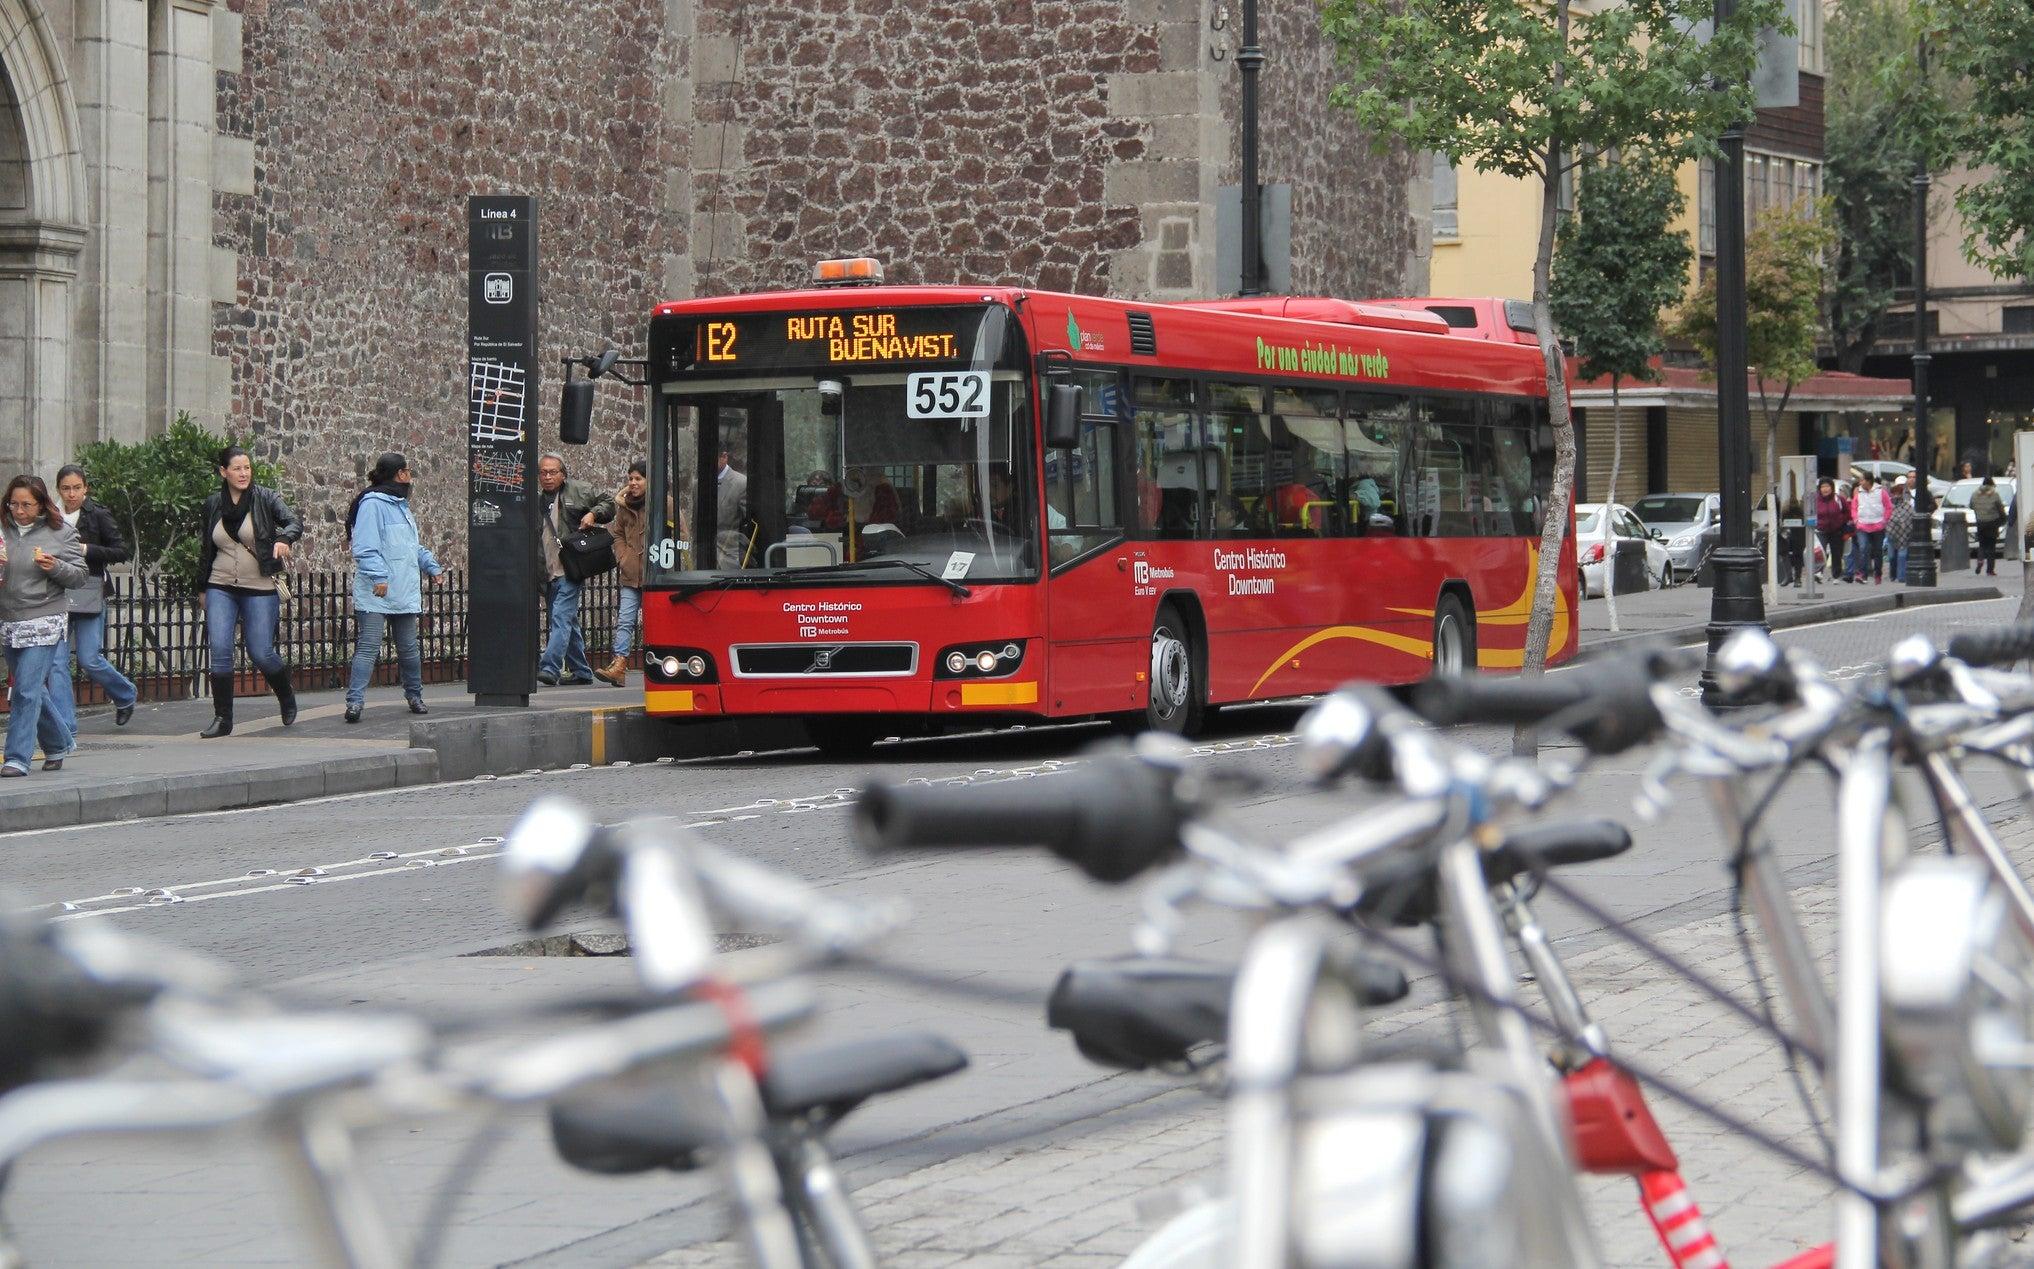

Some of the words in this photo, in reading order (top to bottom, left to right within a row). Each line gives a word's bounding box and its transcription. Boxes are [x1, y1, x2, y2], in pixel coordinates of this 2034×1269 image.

[480, 208, 508, 219] Línea
[509, 208, 517, 219] 4
[787, 316, 844, 340] RUTA
[852, 314, 896, 338] SUR
[708, 322, 737, 361] E2
[1256, 336, 1276, 370] Por
[1277, 346, 1299, 371] una
[1301, 340, 1337, 375] ciudad
[1360, 348, 1389, 379] verde
[915, 374, 984, 415] 552
[950, 561, 968, 572] 17
[1214, 548, 1245, 571] Centro
[1246, 547, 1286, 570] Histórico
[1228, 573, 1275, 596] Downtown
[783, 602, 816, 612] Centro
[818, 601, 862, 612] Histórico
[797, 614, 848, 624] Downtown
[818, 627, 849, 636] Metrobús
